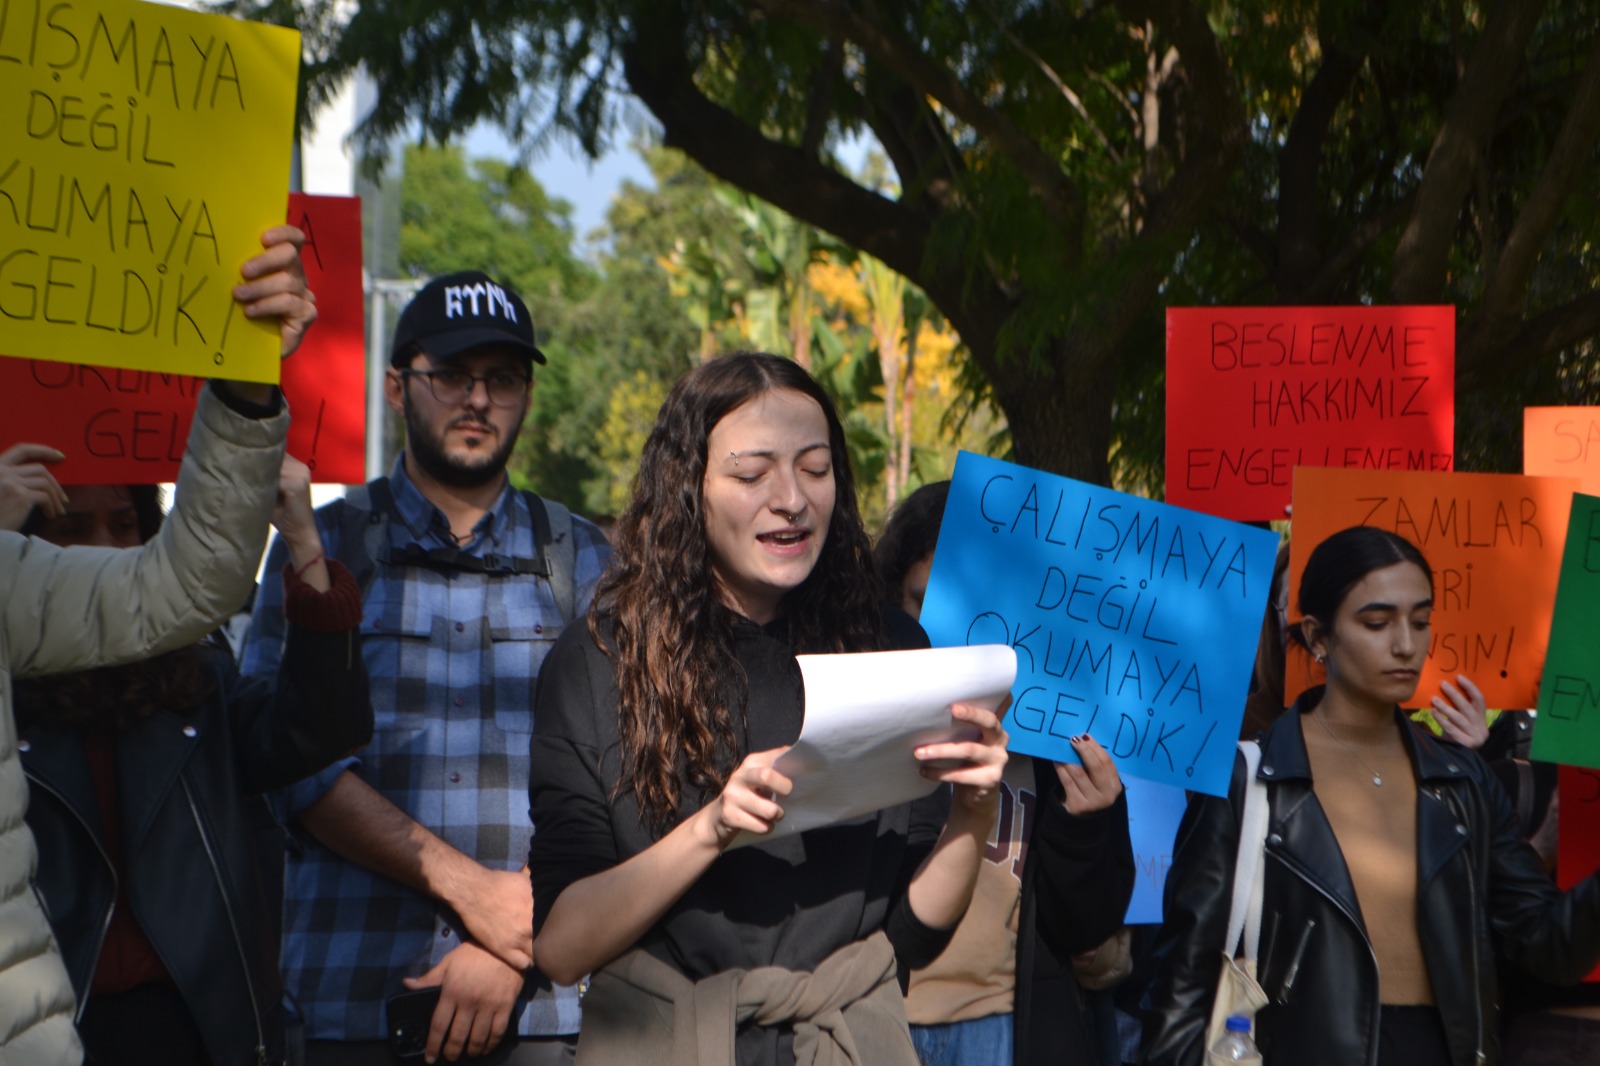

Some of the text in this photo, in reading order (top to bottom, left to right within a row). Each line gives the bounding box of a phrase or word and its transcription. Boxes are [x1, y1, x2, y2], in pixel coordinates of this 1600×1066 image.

[26, 89, 175, 168] DEĞİL
[1210, 321, 1435, 371] BESLENME
[1252, 376, 1430, 428] HAKKIMIZ
[980, 475, 1247, 598] ÇALIŞMAYA
[1355, 496, 1544, 549] ZAMLAR
[1036, 566, 1178, 645] DEĞİL
[966, 611, 1203, 714] OKUMAYA
